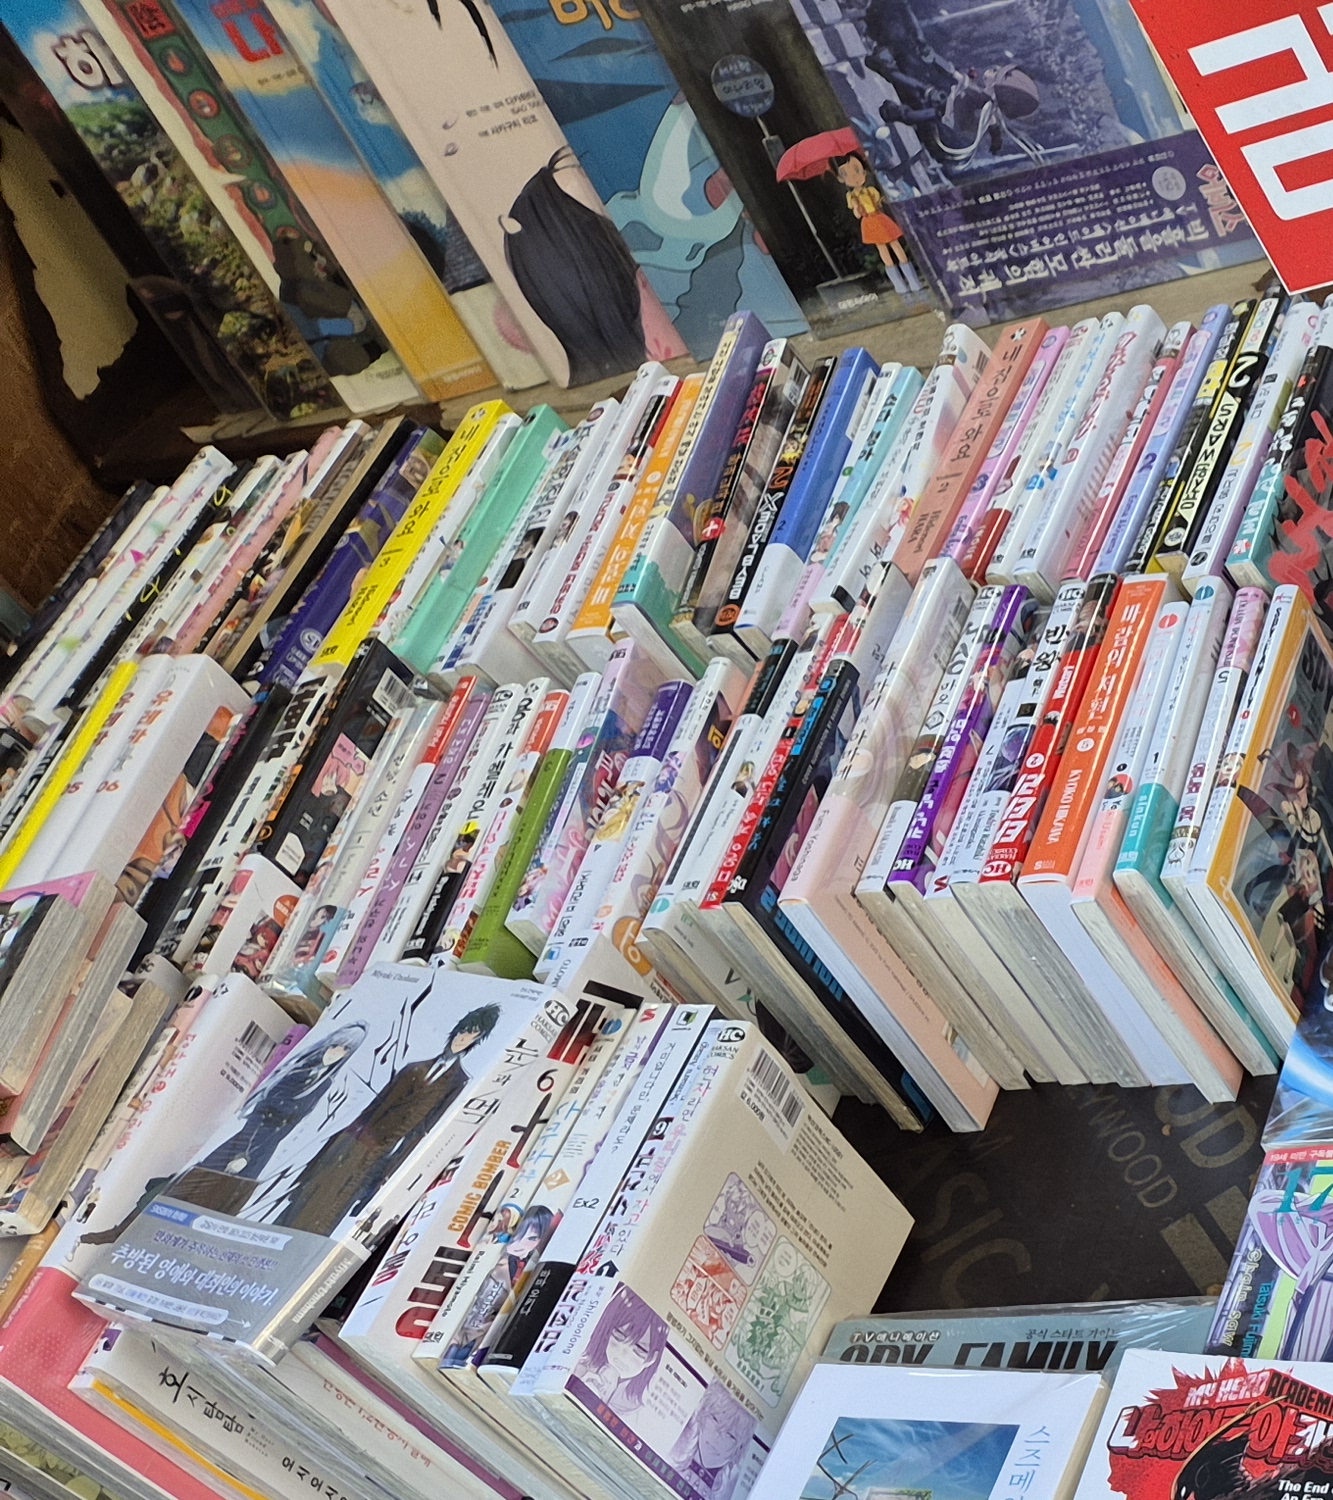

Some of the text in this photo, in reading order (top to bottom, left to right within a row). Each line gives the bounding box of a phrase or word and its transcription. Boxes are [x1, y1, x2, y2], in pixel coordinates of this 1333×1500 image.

[950, 425, 983, 463] 와요
[96, 780, 119, 793] 06
[1128, 794, 1149, 837] sinkun
[450, 1140, 512, 1233] COMIC BOMBER
[1251, 1281, 1275, 1320] Tatsuki
[1184, 1383, 1217, 1408] MY
[1215, 1371, 1270, 1403] HERO
[1278, 1480, 1306, 1494] The
[1308, 1481, 1329, 1494] End
